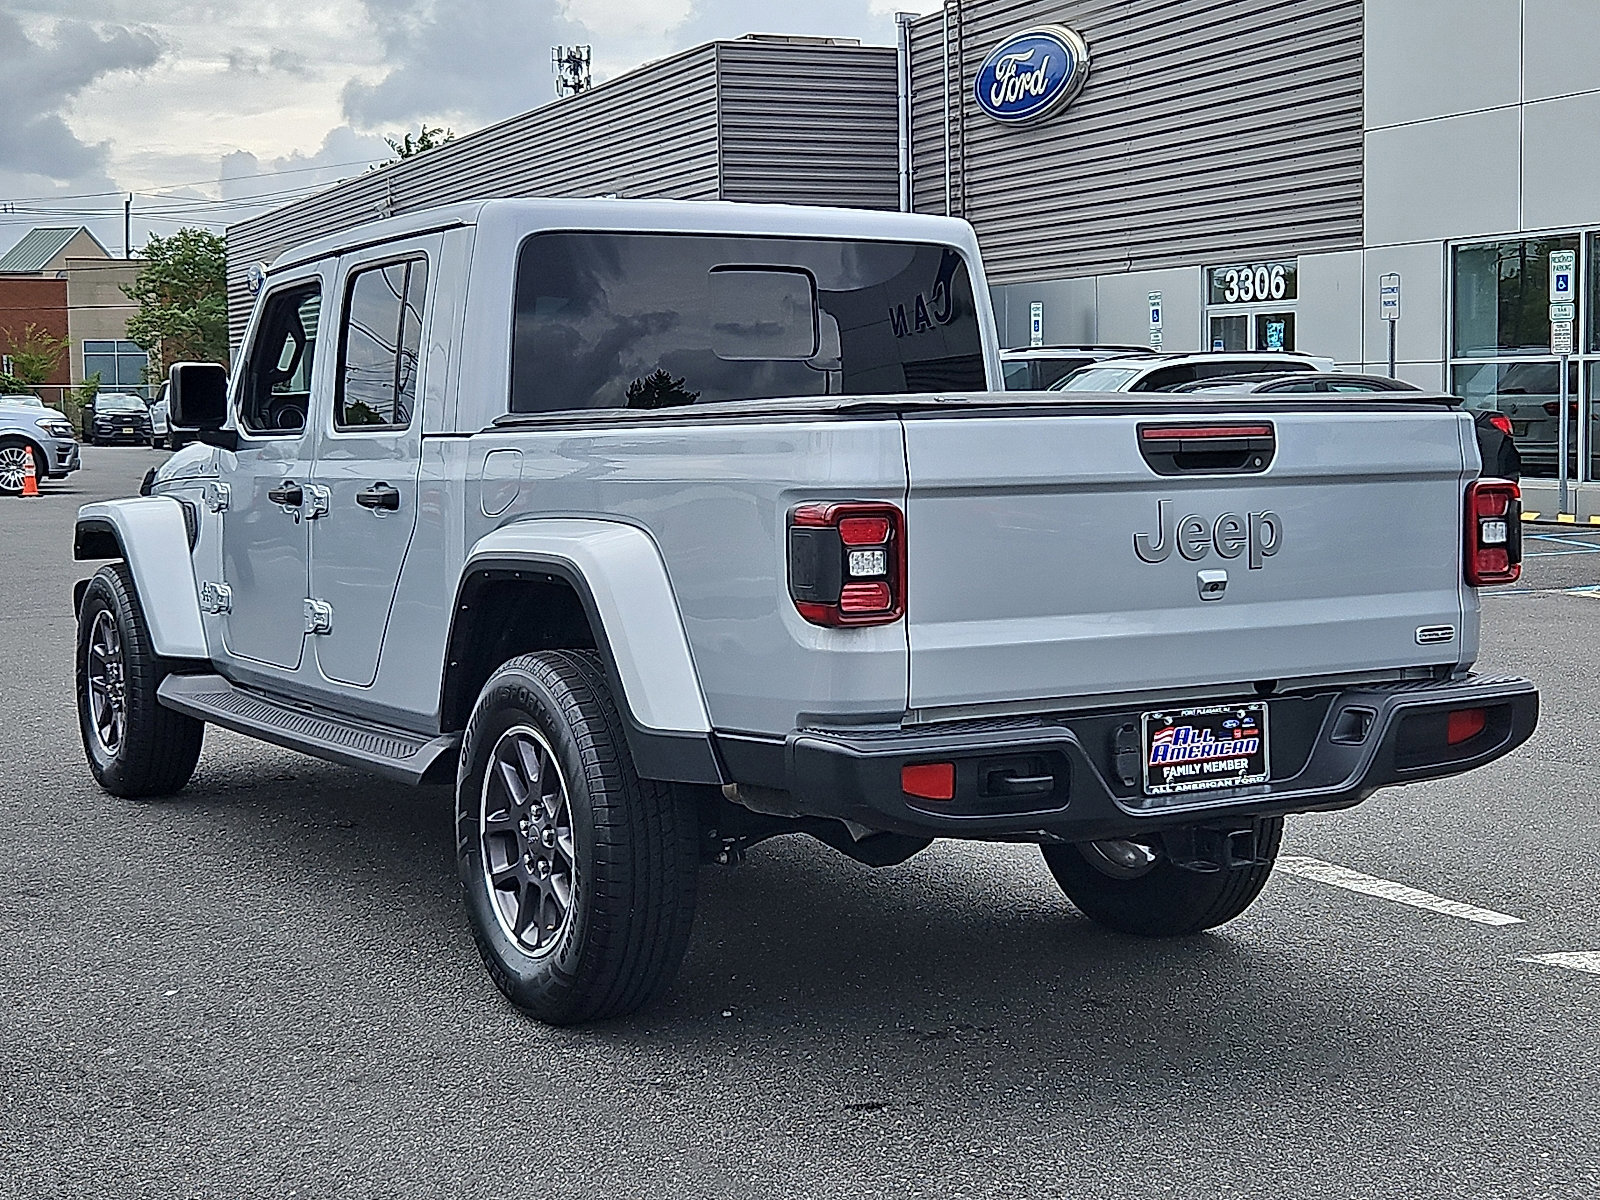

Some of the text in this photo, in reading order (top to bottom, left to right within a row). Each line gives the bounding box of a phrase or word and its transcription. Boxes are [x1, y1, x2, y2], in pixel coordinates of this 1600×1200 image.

[990, 48, 1050, 107] Ford
[1225, 265, 1286, 302] 3306
[1133, 499, 1283, 570] Jeep
[1152, 775, 1265, 794] ALL AMERICAN FORD
[1163, 758, 1248, 778] FAMILY MEMBER
